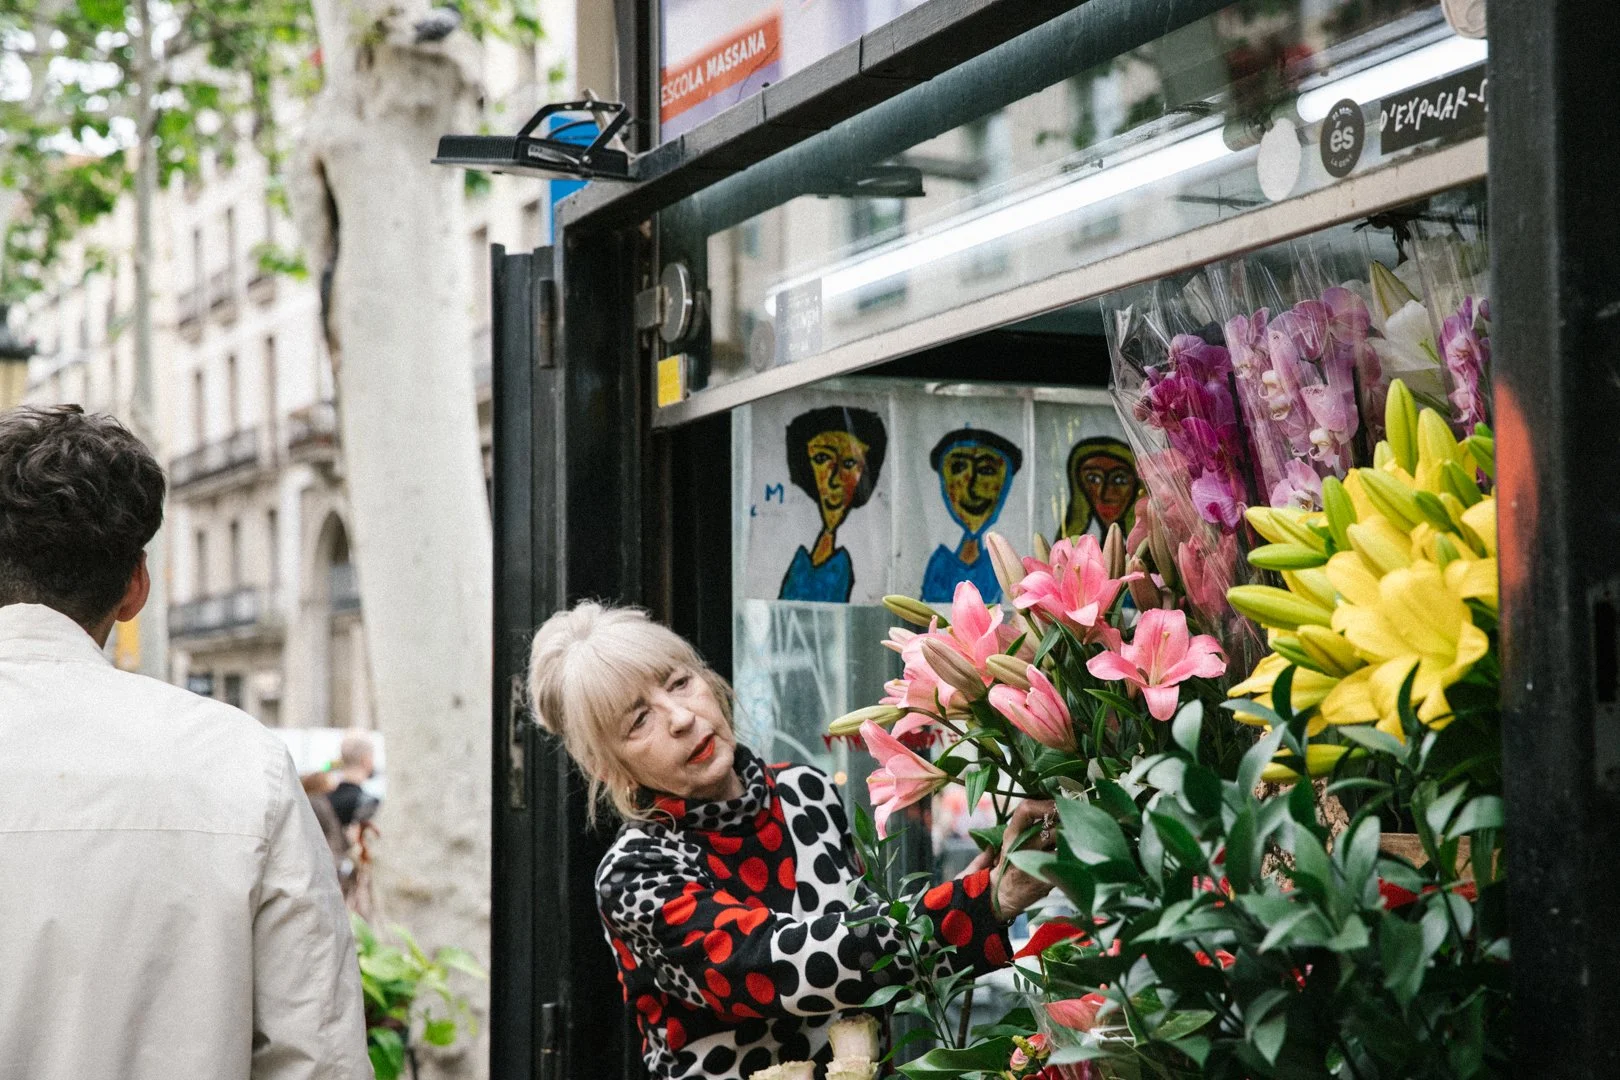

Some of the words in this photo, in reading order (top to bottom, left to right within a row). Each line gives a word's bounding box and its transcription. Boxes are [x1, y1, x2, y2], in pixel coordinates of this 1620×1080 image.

[661, 65, 704, 107] ESCOLA
[706, 29, 766, 81] MASSANA
[1379, 78, 1489, 132] D'EXPOSAR-S
